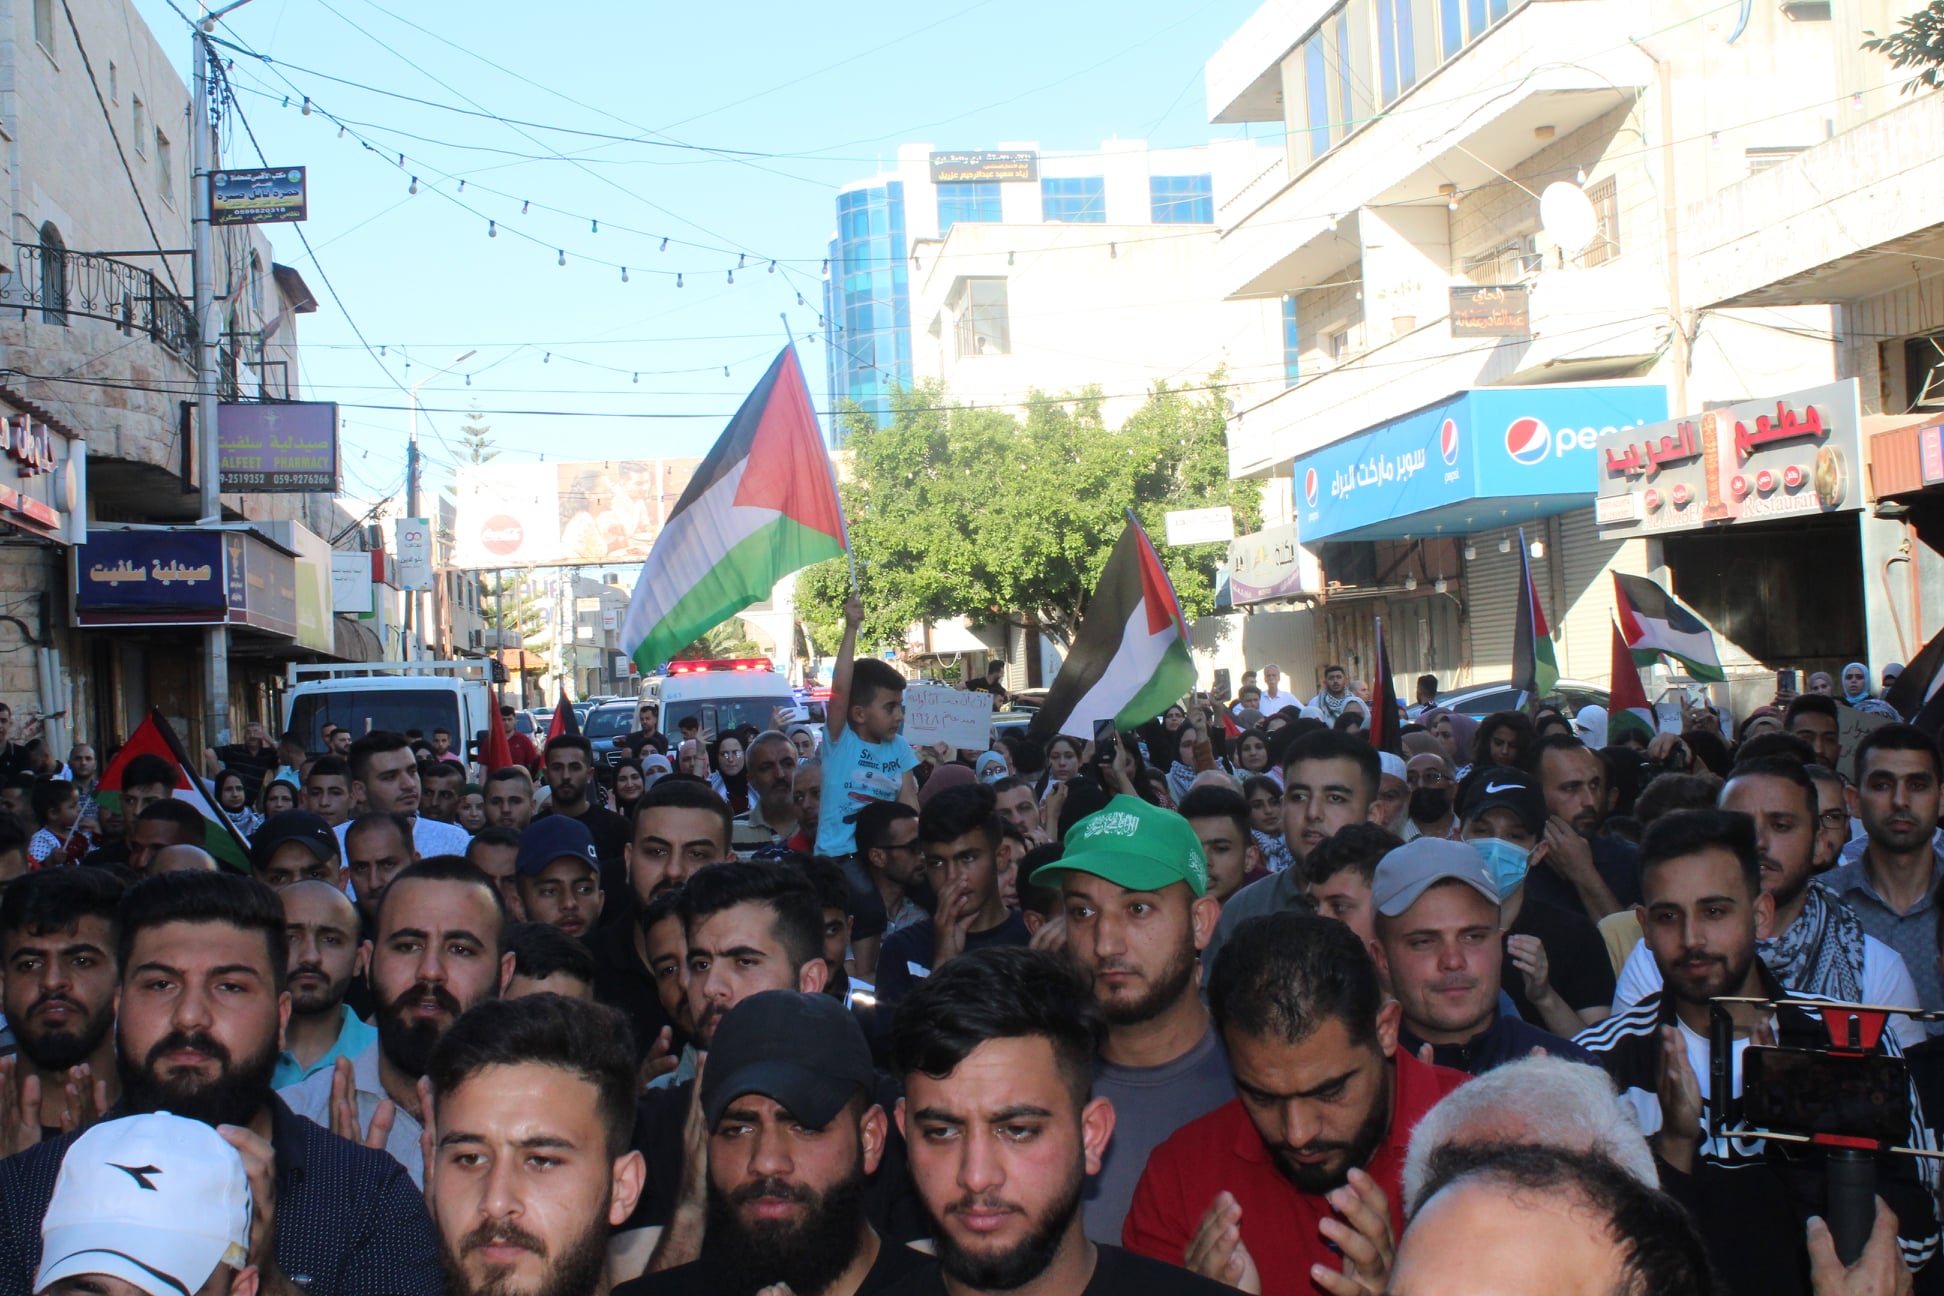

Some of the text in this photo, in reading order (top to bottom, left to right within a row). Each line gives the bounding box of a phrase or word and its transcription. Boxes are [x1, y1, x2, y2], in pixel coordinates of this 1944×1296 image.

[1735, 401, 1822, 456] مطعم
[269, 434, 329, 453] صيدلية
[218, 456, 329, 469] ALFEET PHARMACY
[1357, 454, 1394, 487] ماركت
[1397, 448, 1425, 481] سوبر
[220, 473, 265, 484] 9-2519352
[1743, 491, 1821, 518] Restauran
[89, 559, 212, 587] صيدلية سلفيت
